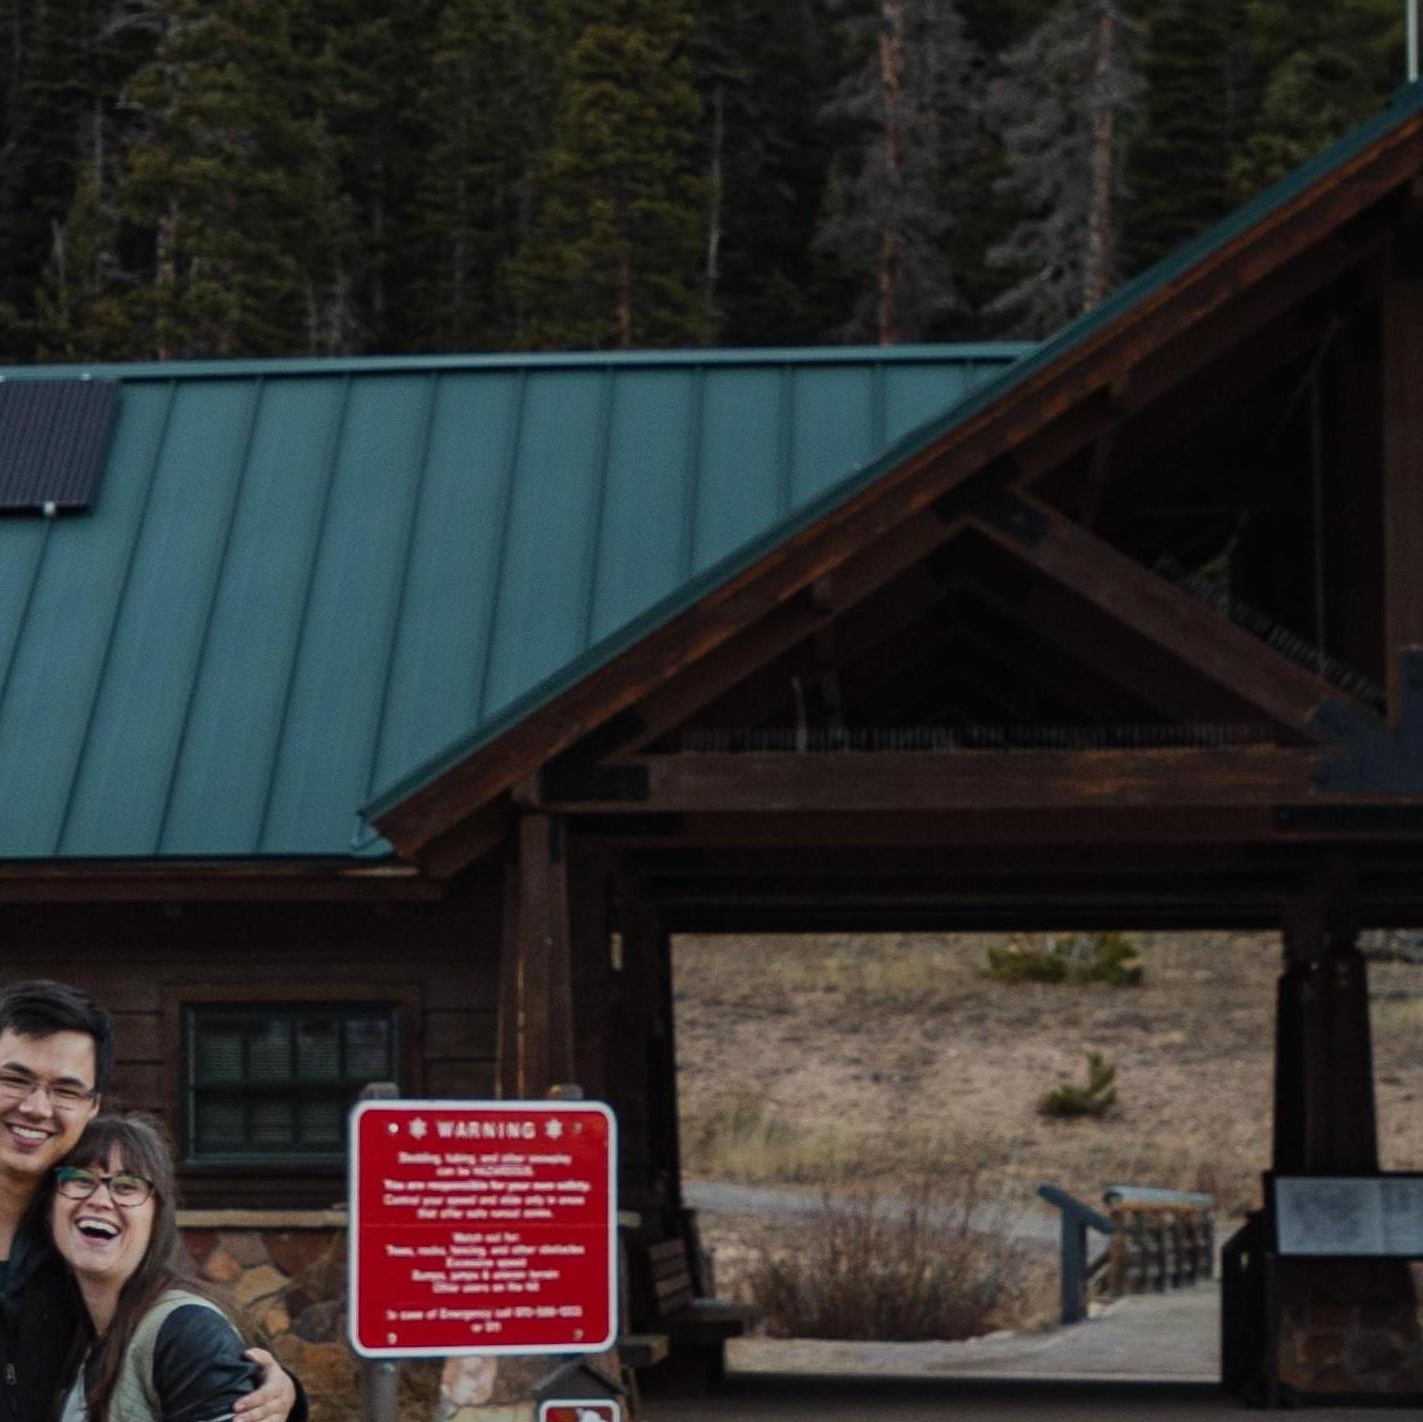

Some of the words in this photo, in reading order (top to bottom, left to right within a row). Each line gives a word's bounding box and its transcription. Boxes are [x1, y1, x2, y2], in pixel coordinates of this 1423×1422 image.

[437, 1121, 535, 1139] WARNING
[384, 1179, 404, 1191] You
[490, 1180, 505, 1190] for
[507, 1181, 530, 1192] your
